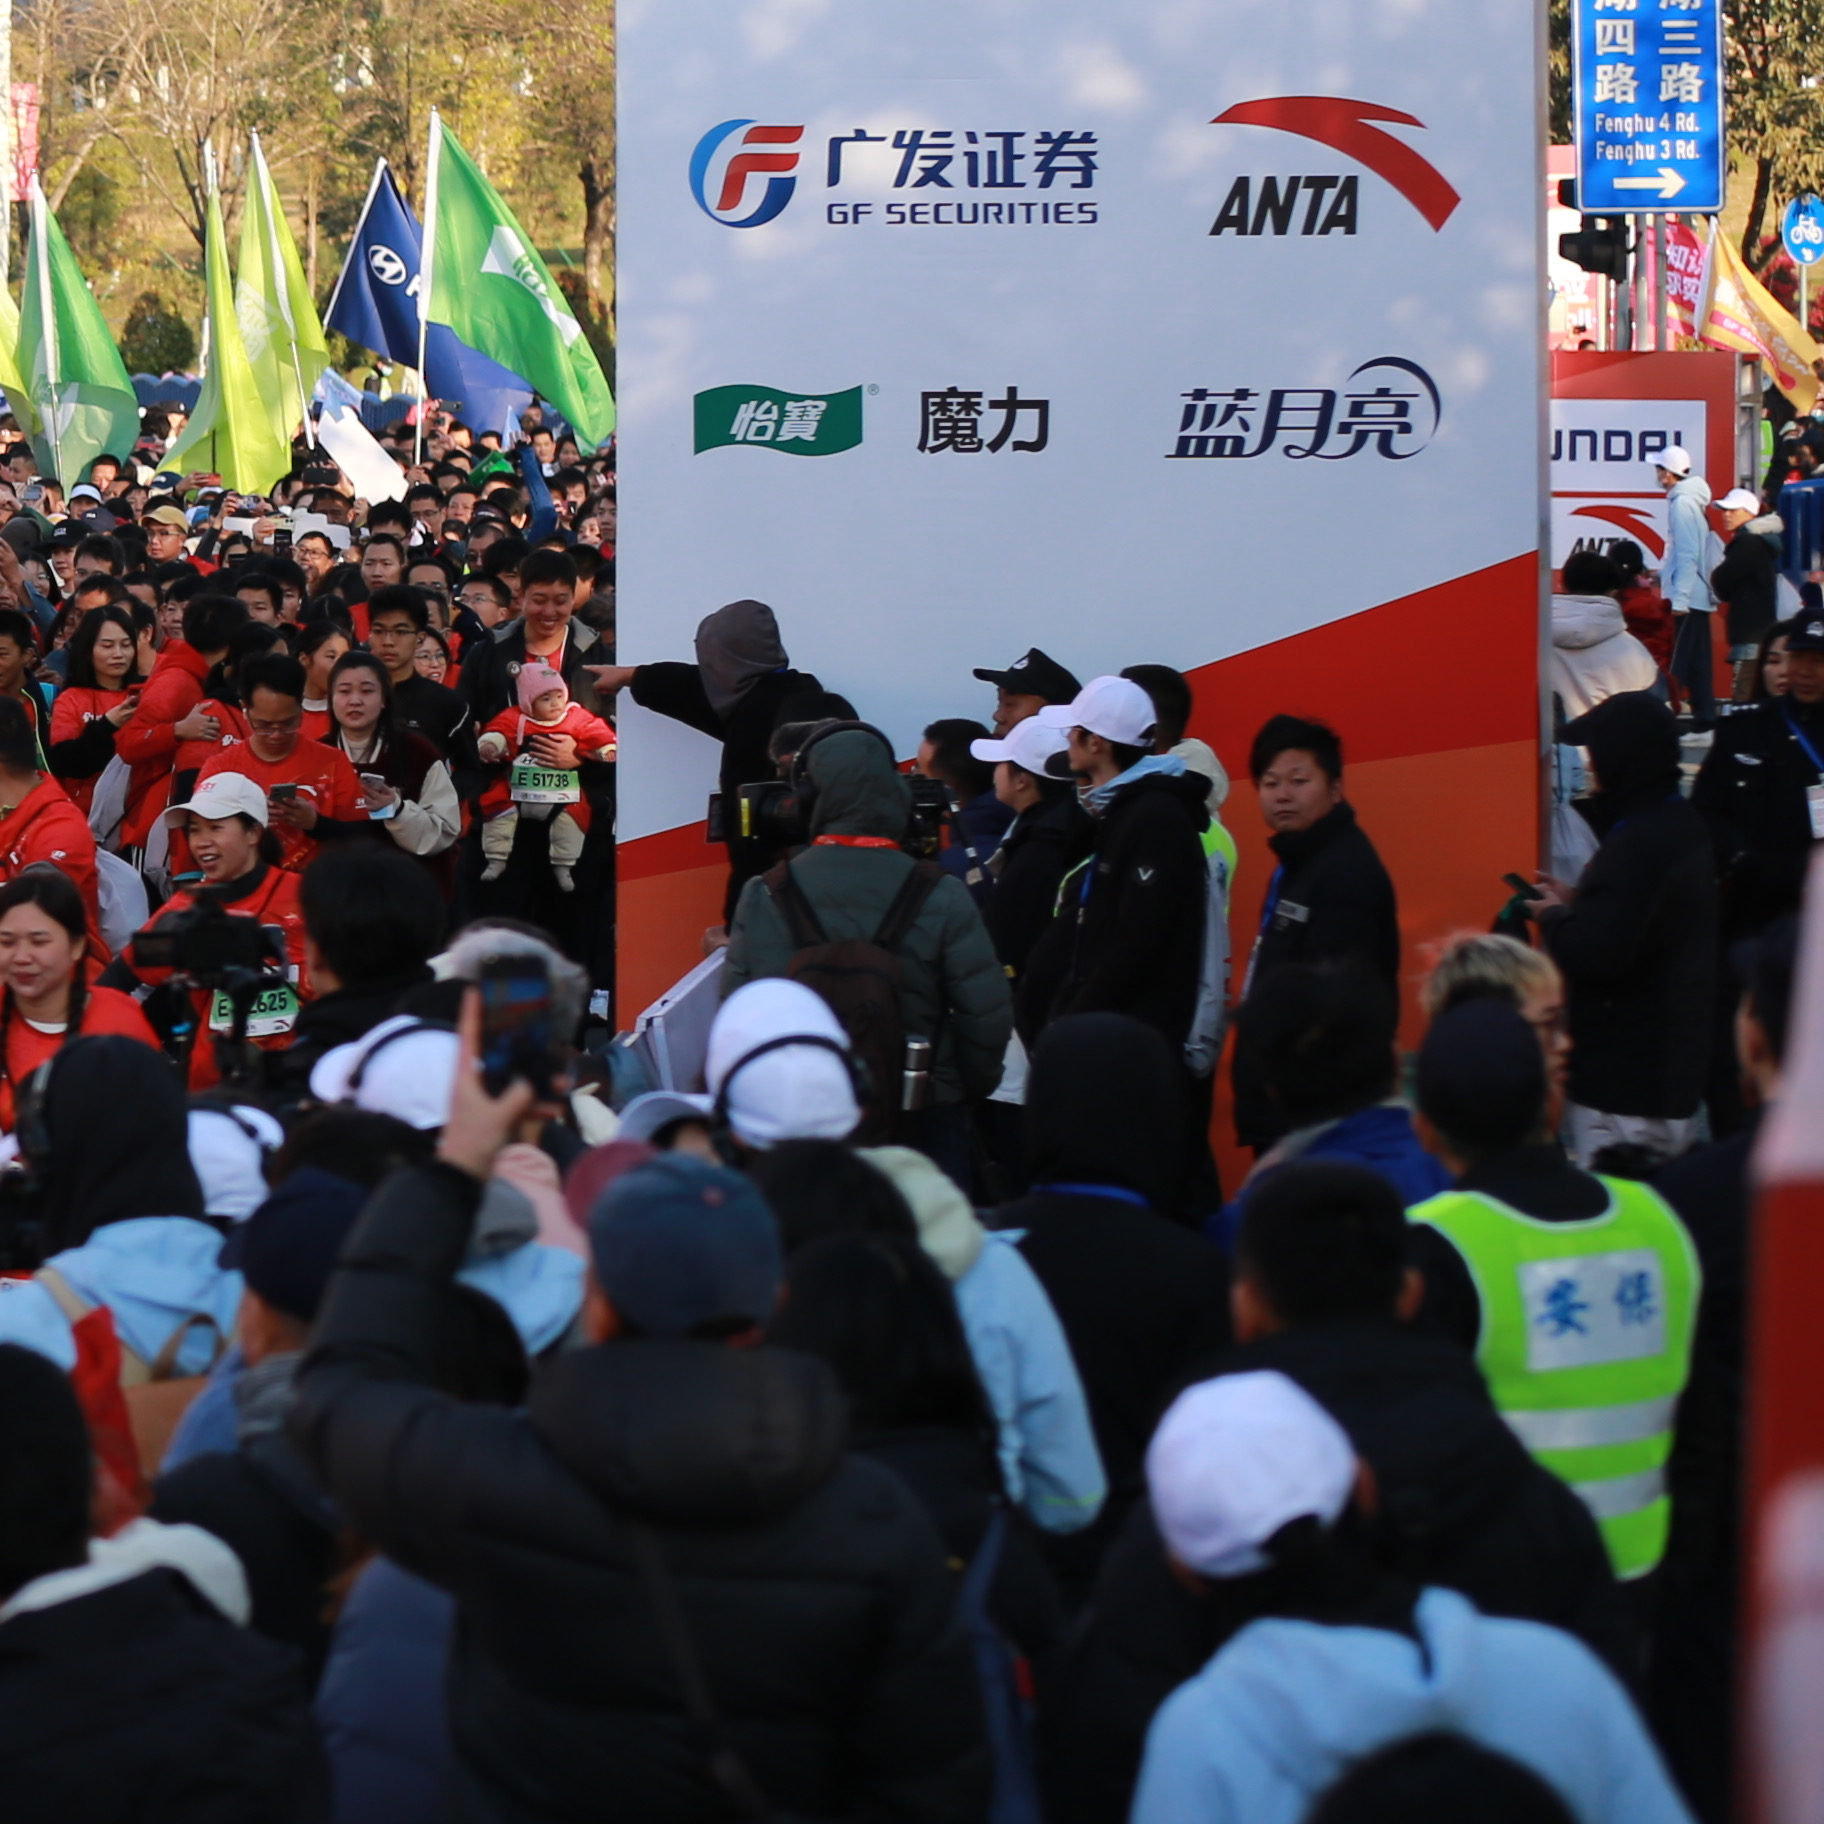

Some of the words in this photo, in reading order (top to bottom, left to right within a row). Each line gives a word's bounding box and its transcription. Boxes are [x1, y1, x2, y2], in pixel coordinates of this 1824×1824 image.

[1595, 113, 1655, 139] Fenghu
[1658, 114, 1672, 132] 4
[1675, 112, 1701, 133] Rd.
[827, 128, 1099, 190] 广发证券
[1596, 141, 1656, 166] Fenghu
[1660, 140, 1671, 160] 3
[1675, 139, 1701, 160] Rd.
[827, 201, 875, 226] GF
[885, 199, 1099, 226] SECURITIES
[1209, 175, 1359, 236] ANTA
[916, 386, 1051, 454] 魔力
[1164, 381, 1424, 461] 蓝月亮
[1551, 429, 1683, 462] NDAI
[518, 772, 527, 786] E
[531, 773, 570, 788] 51738
